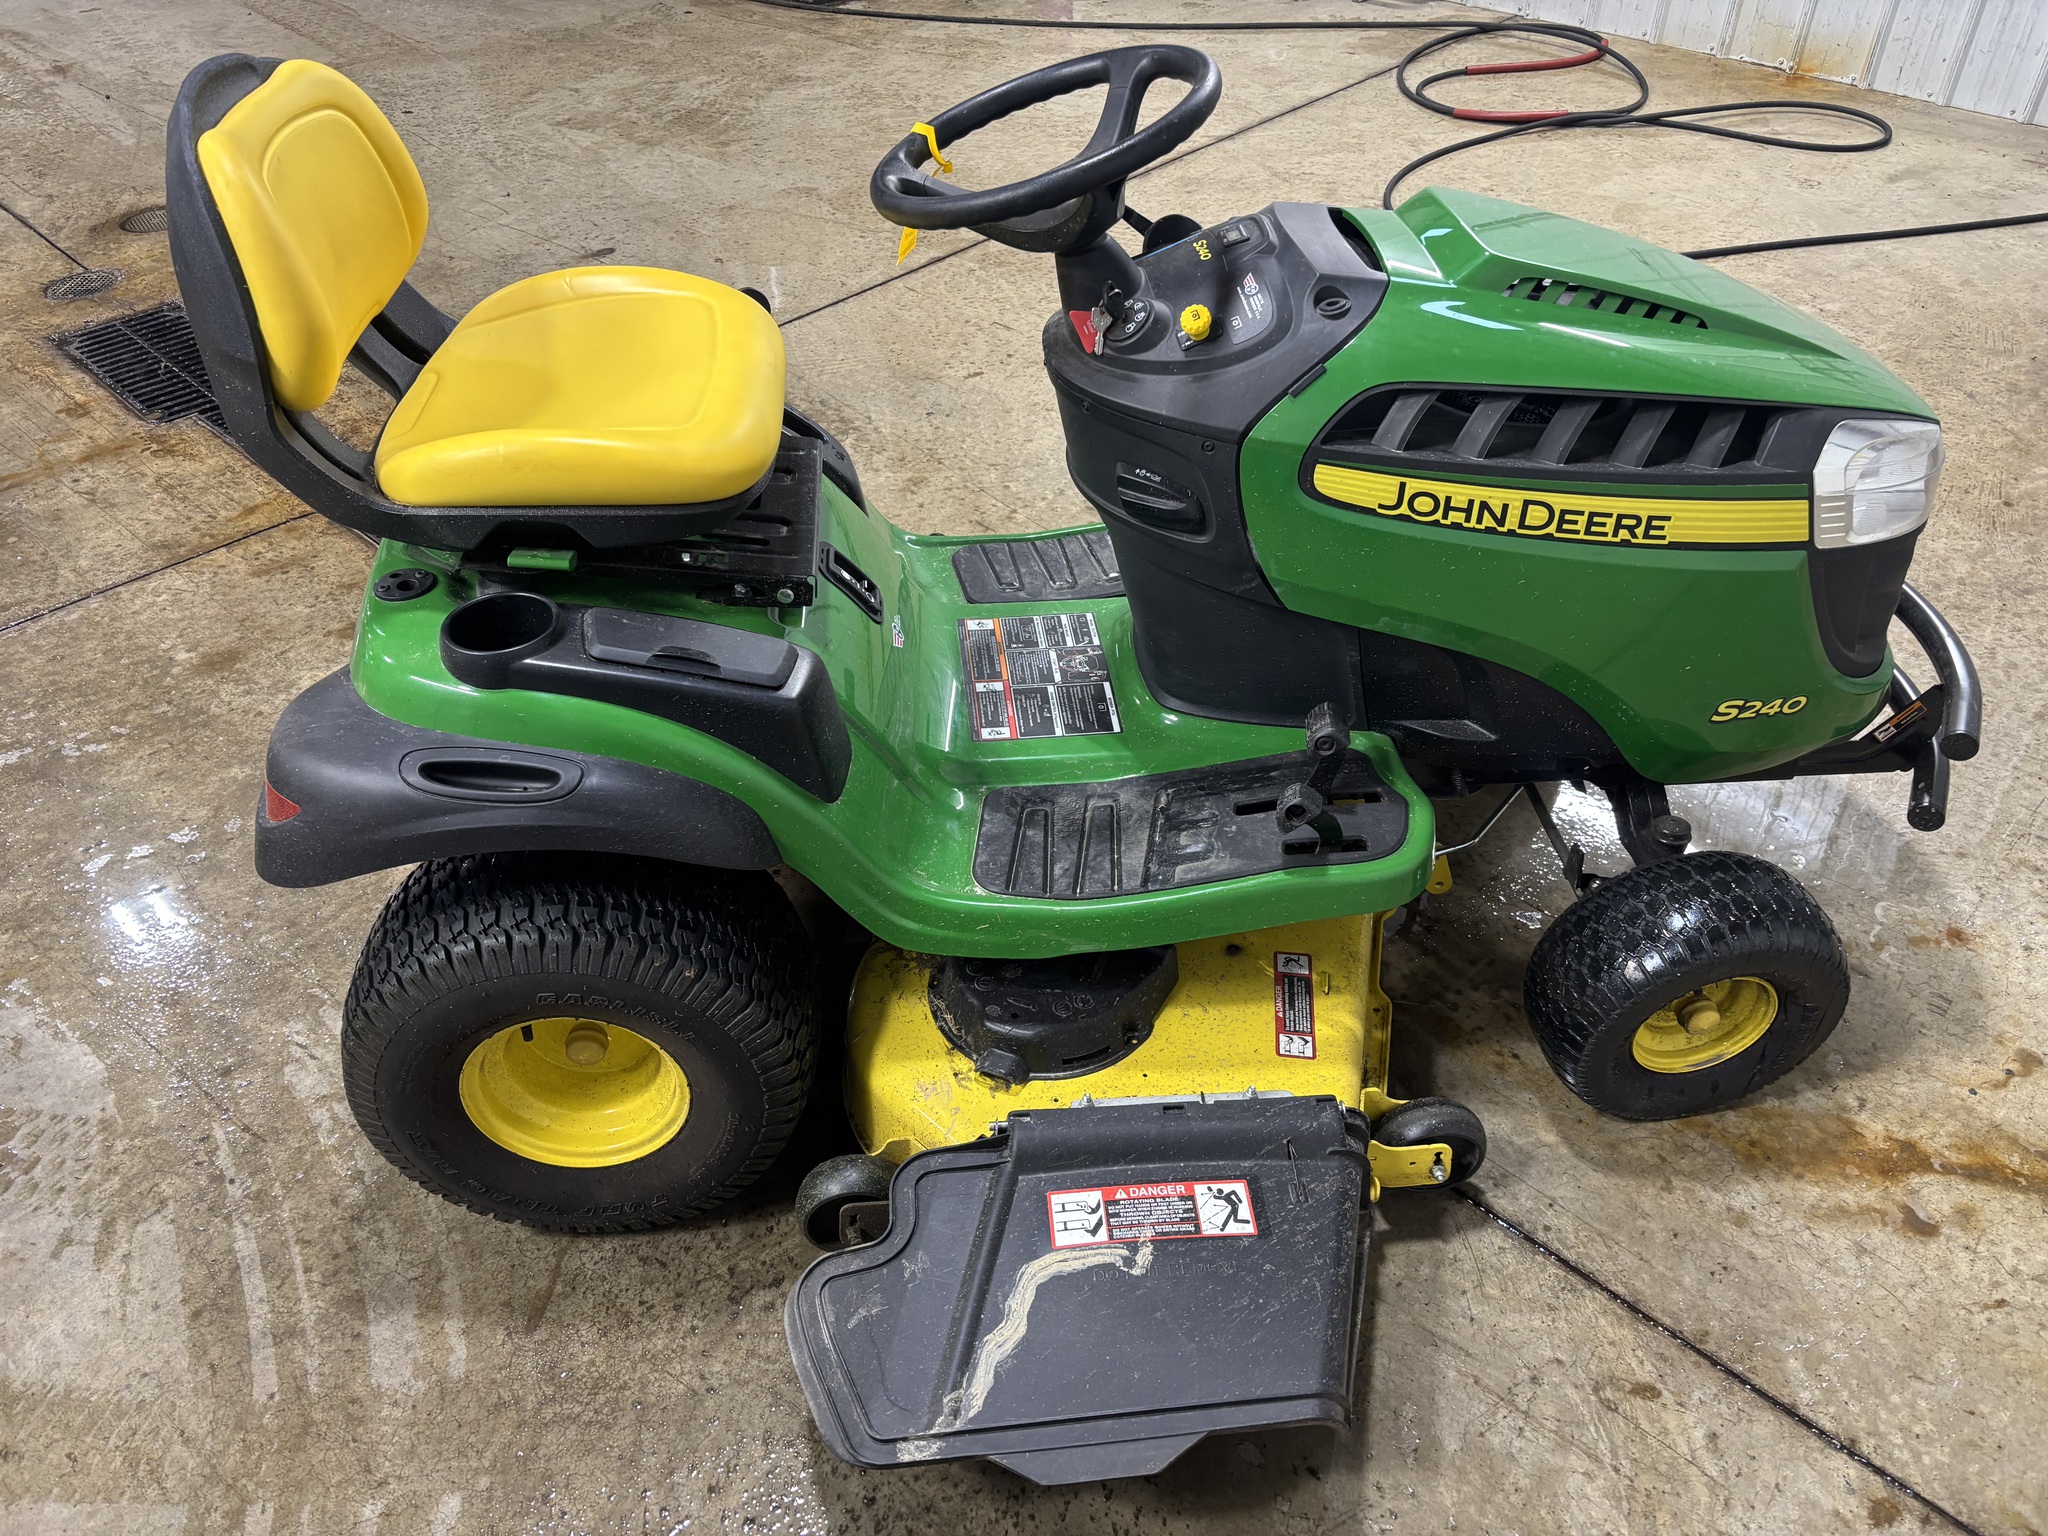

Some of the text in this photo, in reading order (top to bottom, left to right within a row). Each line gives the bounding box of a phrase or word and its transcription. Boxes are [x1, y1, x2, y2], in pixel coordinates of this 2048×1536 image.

[1193, 240, 1212, 260] S240
[1377, 481, 1672, 540] JOHN DEERE
[1709, 695, 1809, 722] S240
[1129, 1185, 1185, 1197] DANGER
[1093, 1268, 1119, 1281] DO
[1168, 1260, 1246, 1276] REMOVE
